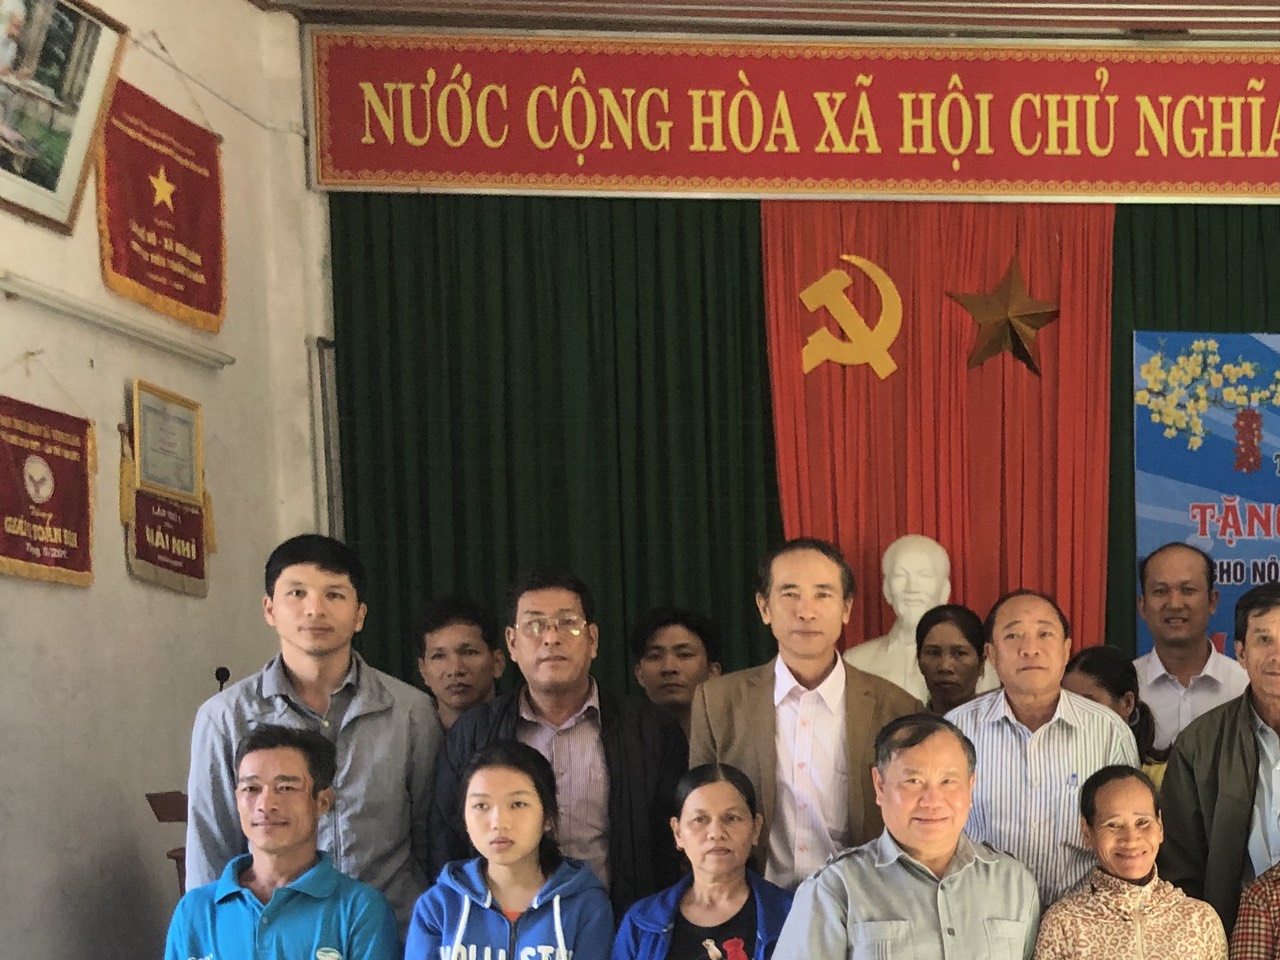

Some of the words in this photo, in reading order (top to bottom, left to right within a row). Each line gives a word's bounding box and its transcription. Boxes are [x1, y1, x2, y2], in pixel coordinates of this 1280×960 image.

[360, 63, 509, 148] NƯỚC
[526, 67, 673, 167] CỘNG
[688, 70, 800, 154] HÒA
[815, 74, 882, 155] XÃ
[898, 74, 993, 171] HỘI
[1010, 67, 1119, 158] CHỦ
